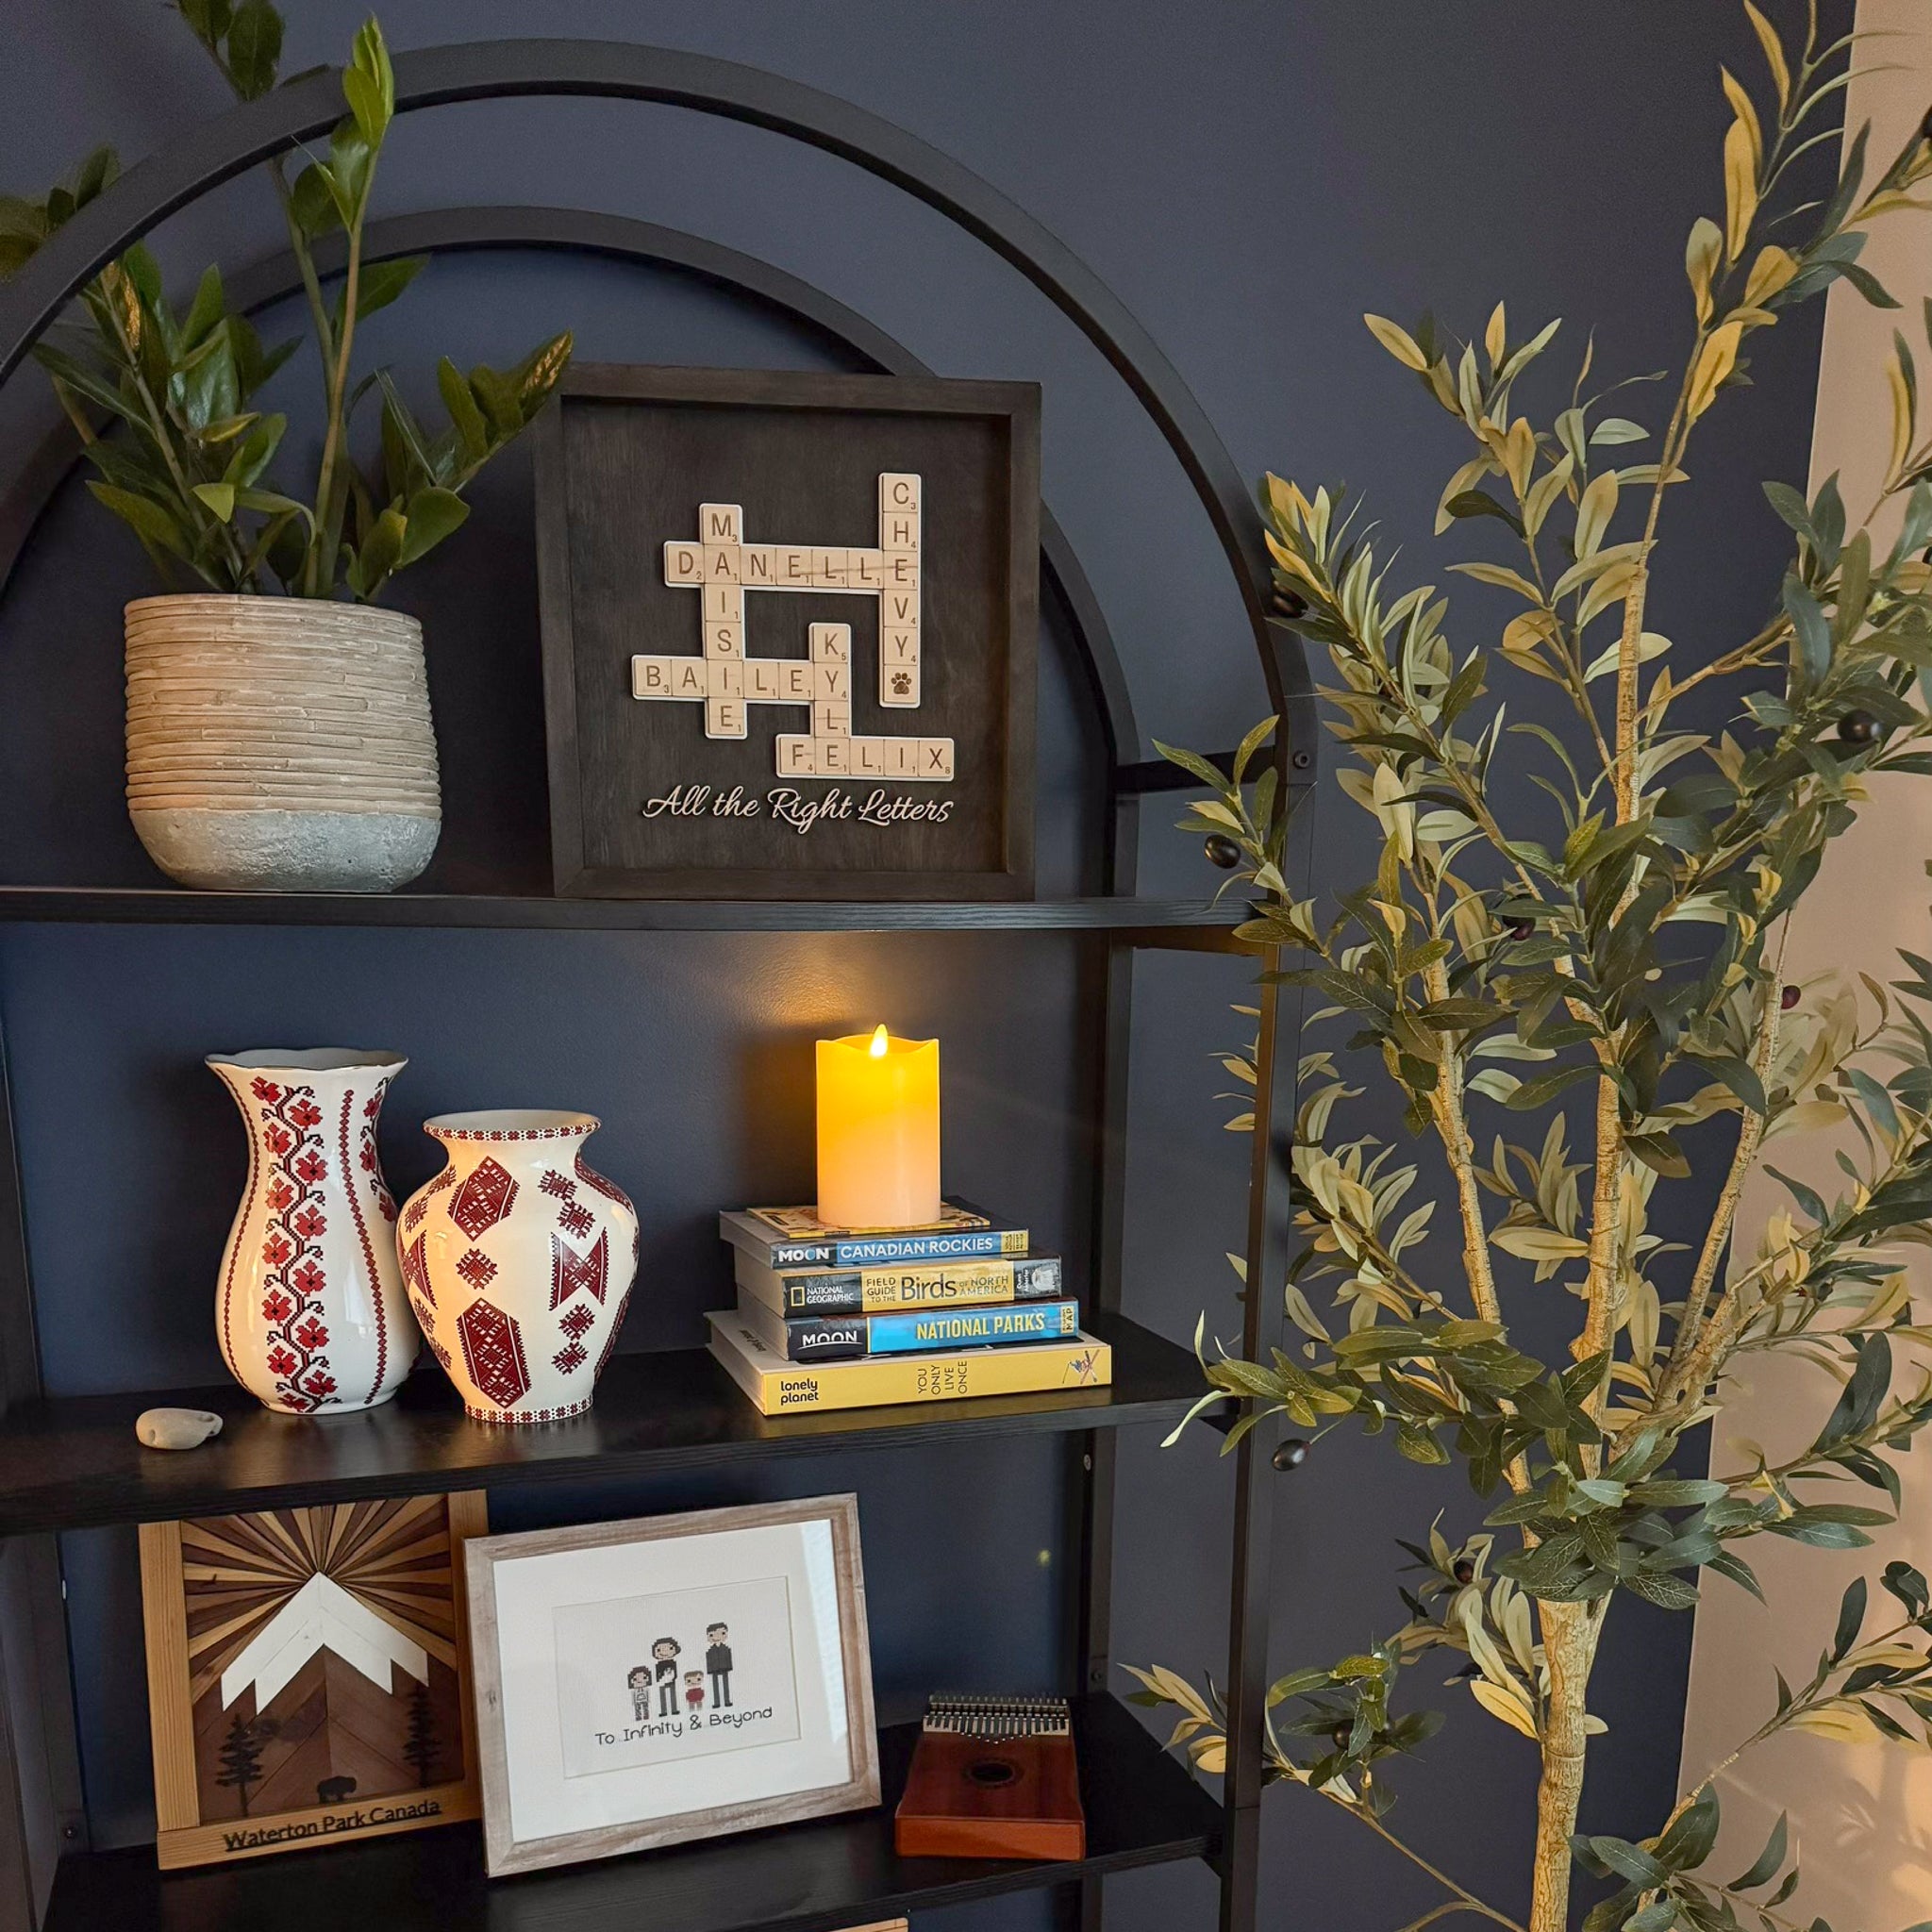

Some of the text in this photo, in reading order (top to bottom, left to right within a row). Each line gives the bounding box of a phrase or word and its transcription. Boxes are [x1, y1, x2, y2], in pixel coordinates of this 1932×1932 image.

[678, 550, 908, 582] DANELLE
[892, 481, 909, 658] CHEVY
[711, 512, 734, 727] MAISIE
[645, 664, 839, 693] BAILEY
[824, 632, 840, 767] KYLE
[792, 743, 943, 770] FELIX
[642, 785, 955, 834] All the Right Letters
[778, 1247, 829, 1262] MOON
[840, 1241, 924, 1259] CANADIAN
[928, 1237, 993, 1253] ROCKIES
[807, 1285, 843, 1296] NATIONAL
[866, 1277, 896, 1287] FIELD
[866, 1287, 896, 1296] GUIDE
[901, 1274, 958, 1301] Birds
[958, 1284, 1008, 1297] AMERICA
[970, 1274, 1008, 1286] NORTH
[807, 1292, 855, 1304] GEOGRAPHIC
[802, 1330, 858, 1347] MOON
[915, 1318, 991, 1340] NATIONAL
[993, 1312, 1045, 1334] PARKS
[780, 1378, 819, 1392] lonely
[917, 1368, 927, 1394] YOU
[930, 1364, 941, 1395] ONLY
[944, 1367, 955, 1391] LIVE
[958, 1360, 968, 1394] ONCE
[780, 1391, 819, 1406] planet
[594, 1706, 773, 1746] To Infinity & Beyond
[222, 1798, 442, 1852] Waterton Park Canada
